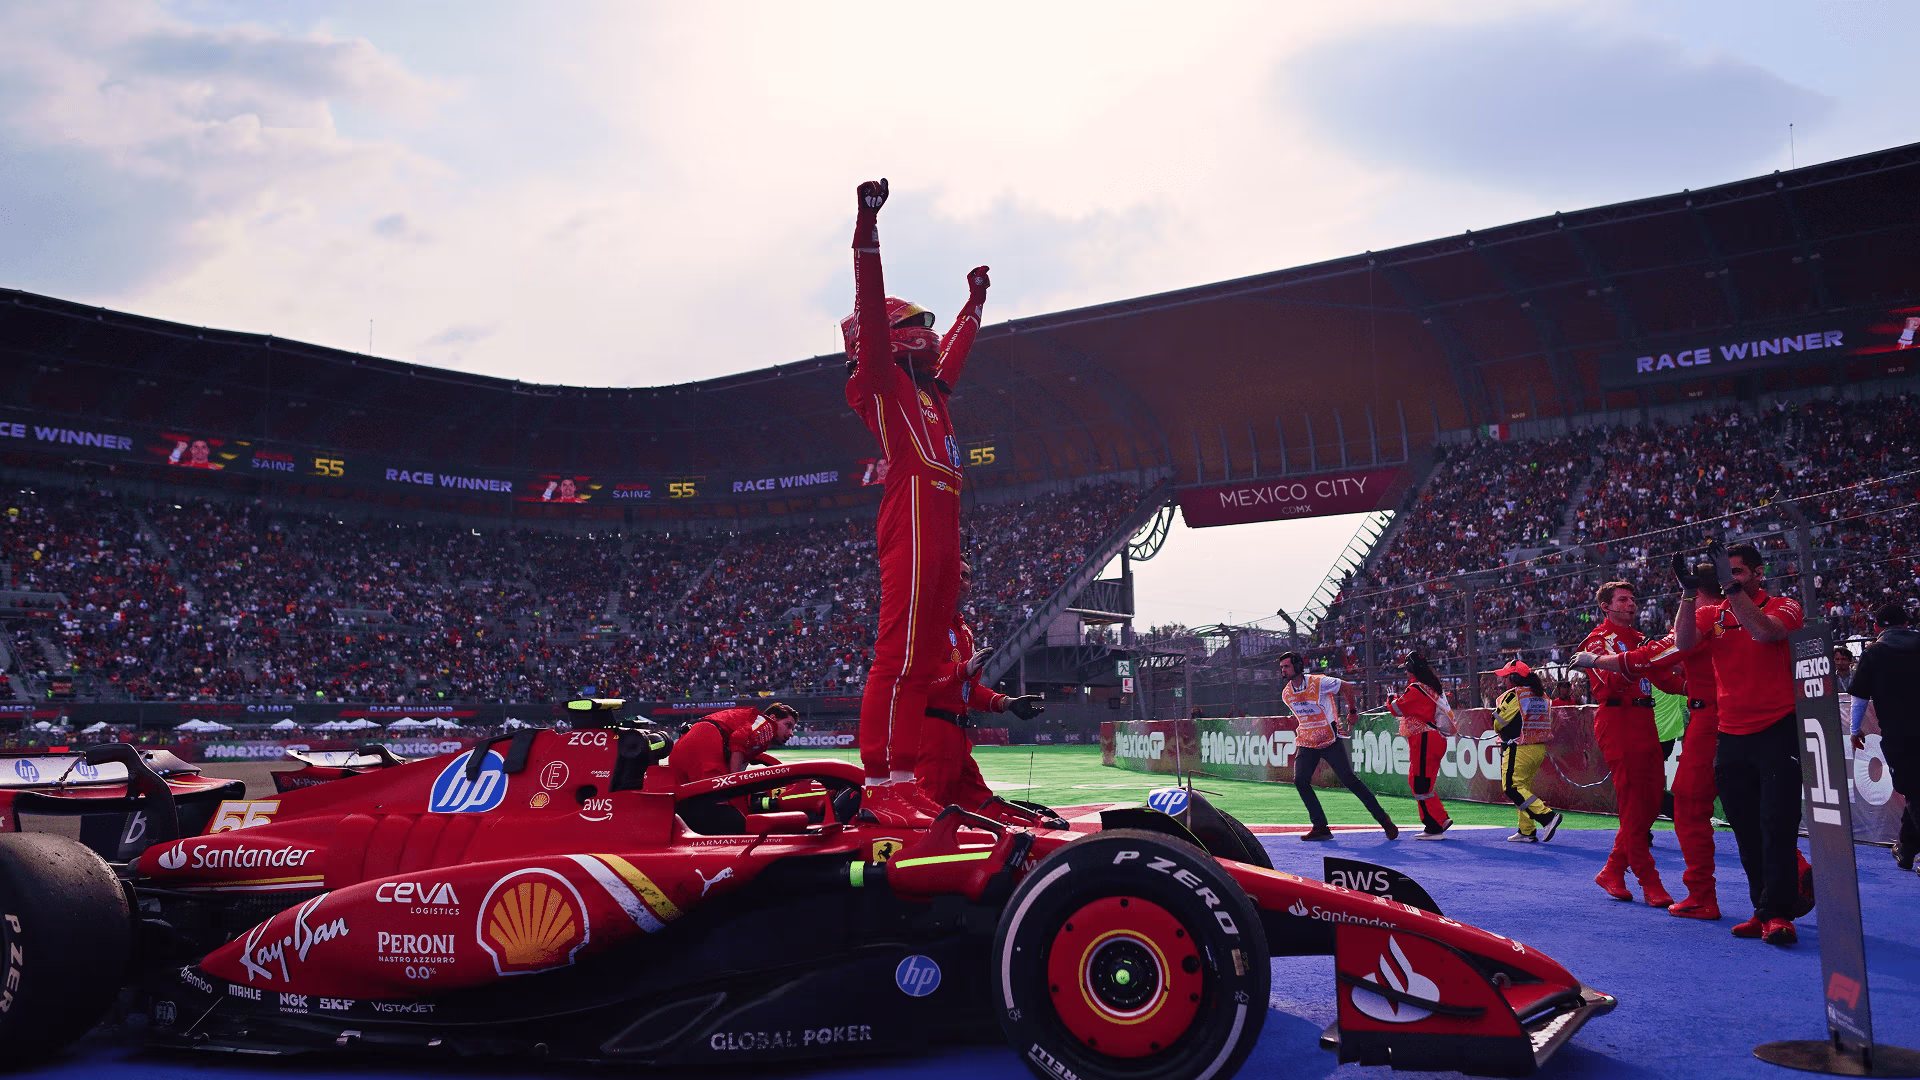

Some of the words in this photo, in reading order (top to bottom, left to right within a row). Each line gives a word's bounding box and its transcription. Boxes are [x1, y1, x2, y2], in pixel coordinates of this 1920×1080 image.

[1637, 348, 1711, 374] RACE
[1720, 330, 1844, 361] WINNER
[0, 421, 26, 438] CE
[34, 425, 133, 451] WINNER
[251, 458, 295, 472] SAINZ
[969, 446, 995, 466] 55
[314, 457, 345, 477] 55
[385, 468, 434, 485] RACE
[439, 474, 513, 493] WINNER
[669, 482, 696, 498] 55
[733, 478, 776, 493] RACE
[778, 470, 839, 489] WINNER
[612, 489, 651, 499] SAINZ
[1219, 483, 1308, 508] MEXICO
[1315, 476, 1368, 498] CITY
[1281, 504, 1313, 515] CDMX
[1795, 656, 1831, 680] MEXICO
[1804, 678, 1825, 698] CITY
[366, 741, 462, 755] MexicoGP
[568, 731, 608, 746] ZCG
[784, 734, 855, 747] MexicoGP
[1201, 730, 1298, 767] #MexicoGP
[1351, 730, 1503, 780] #MecoG
[17, 759, 39, 783] hp
[435, 750, 503, 813] hp
[738, 766, 791, 781] TECHNOLOGY
[583, 798, 613, 811] aws
[210, 799, 282, 834] 55
[690, 838, 738, 847] HARMAN
[191, 845, 315, 869] Santander
[1331, 870, 1390, 892] aws
[1112, 850, 1140, 865] P
[1146, 856, 1240, 935] ZERO
[410, 907, 461, 916] LOGISTICS
[4, 913, 22, 934] P
[377, 931, 456, 955] PERONI
[378, 955, 411, 964] NASTRO
[413, 956, 456, 965] AZZURRO
[0, 941, 23, 1013] ZER
[180, 965, 214, 995] brembo
[405, 966, 437, 980] 0.0%
[899, 955, 939, 997] hp
[228, 983, 263, 1001] MAHLE
[279, 992, 309, 1009] NGK
[319, 998, 355, 1011] SKF
[710, 1031, 798, 1051] GLOBAL
[803, 1024, 873, 1047] POKER
[1028, 1042, 1083, 1080] RELLI
